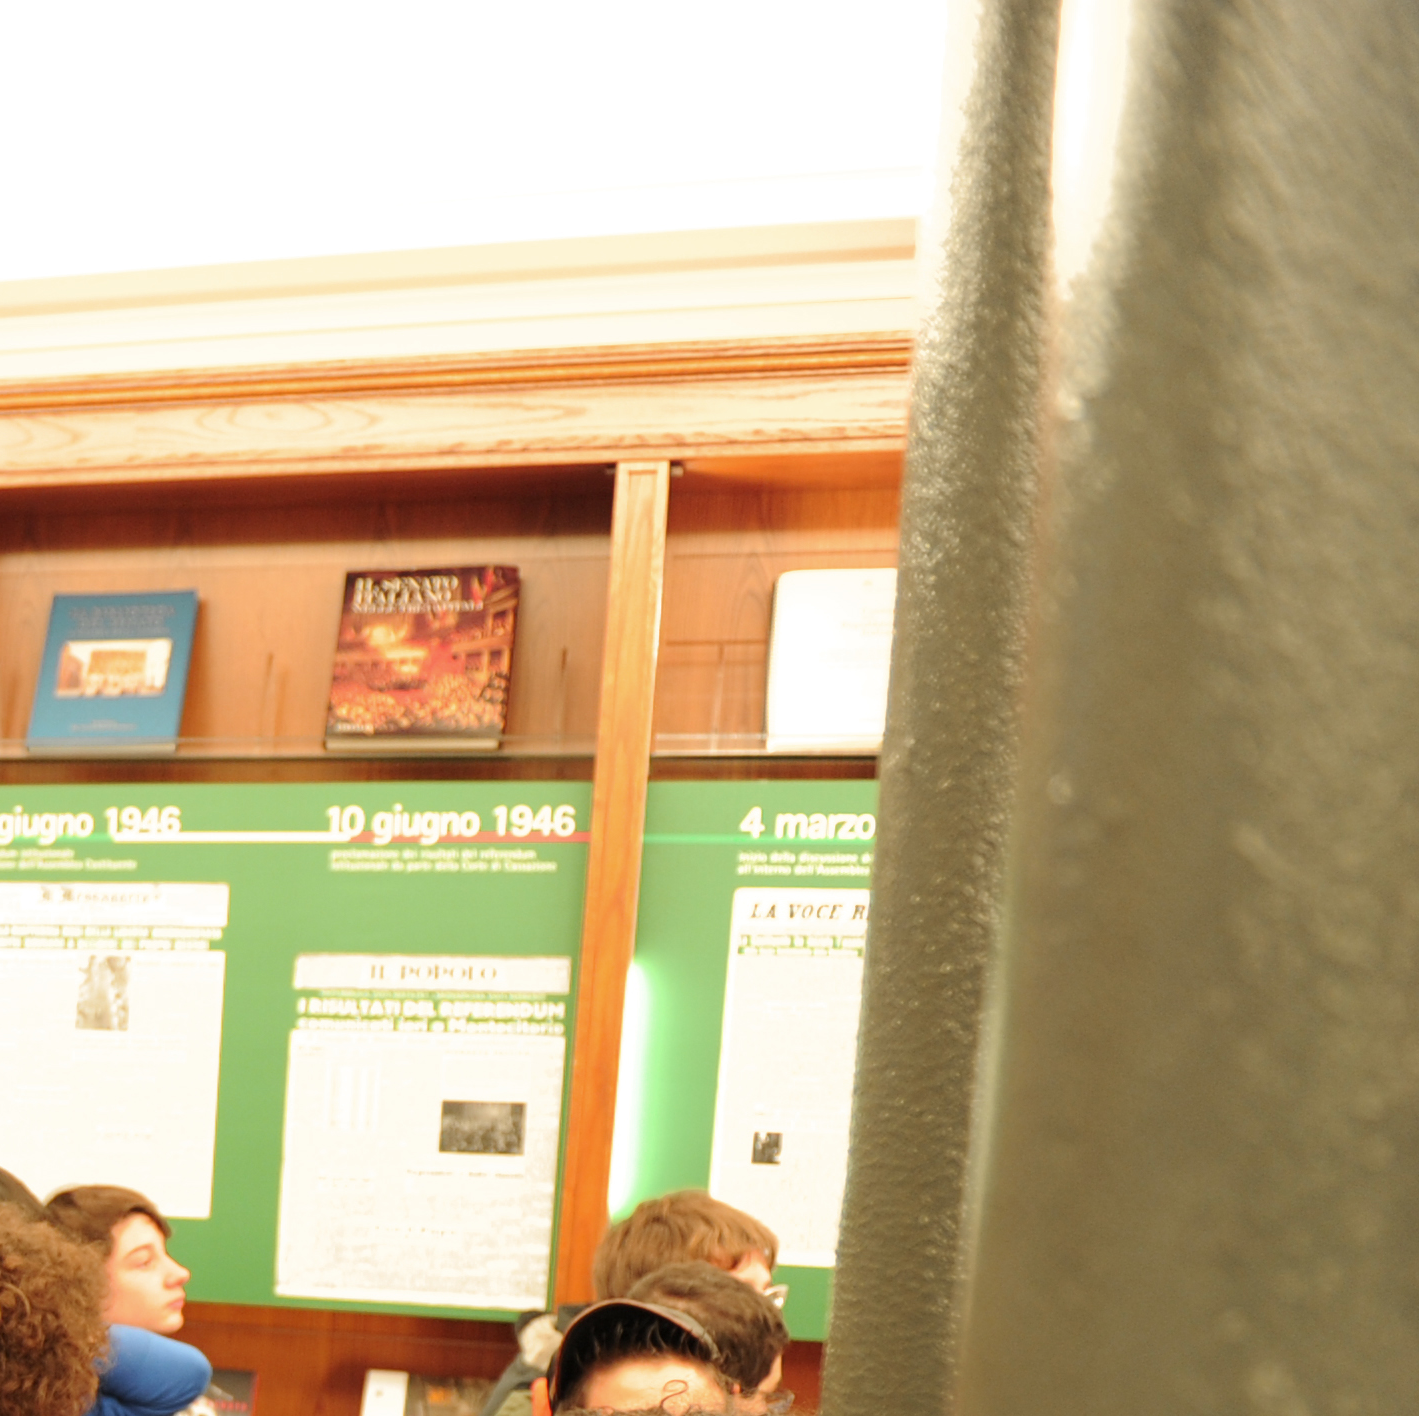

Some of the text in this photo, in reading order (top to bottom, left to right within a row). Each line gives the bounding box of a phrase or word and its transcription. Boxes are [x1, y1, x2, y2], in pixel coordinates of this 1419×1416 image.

[106, 806, 181, 837] 1946
[328, 804, 576, 845] 10 giugno 1946
[739, 806, 876, 841] 4 marzo
[750, 903, 777, 919] LA
[788, 903, 844, 920] VOCE
[370, 965, 498, 980] IL POPOLO
[309, 999, 401, 1015] RISULTATI
[402, 1001, 436, 1017] DEL
[438, 1001, 565, 1018] REFERENDUM
